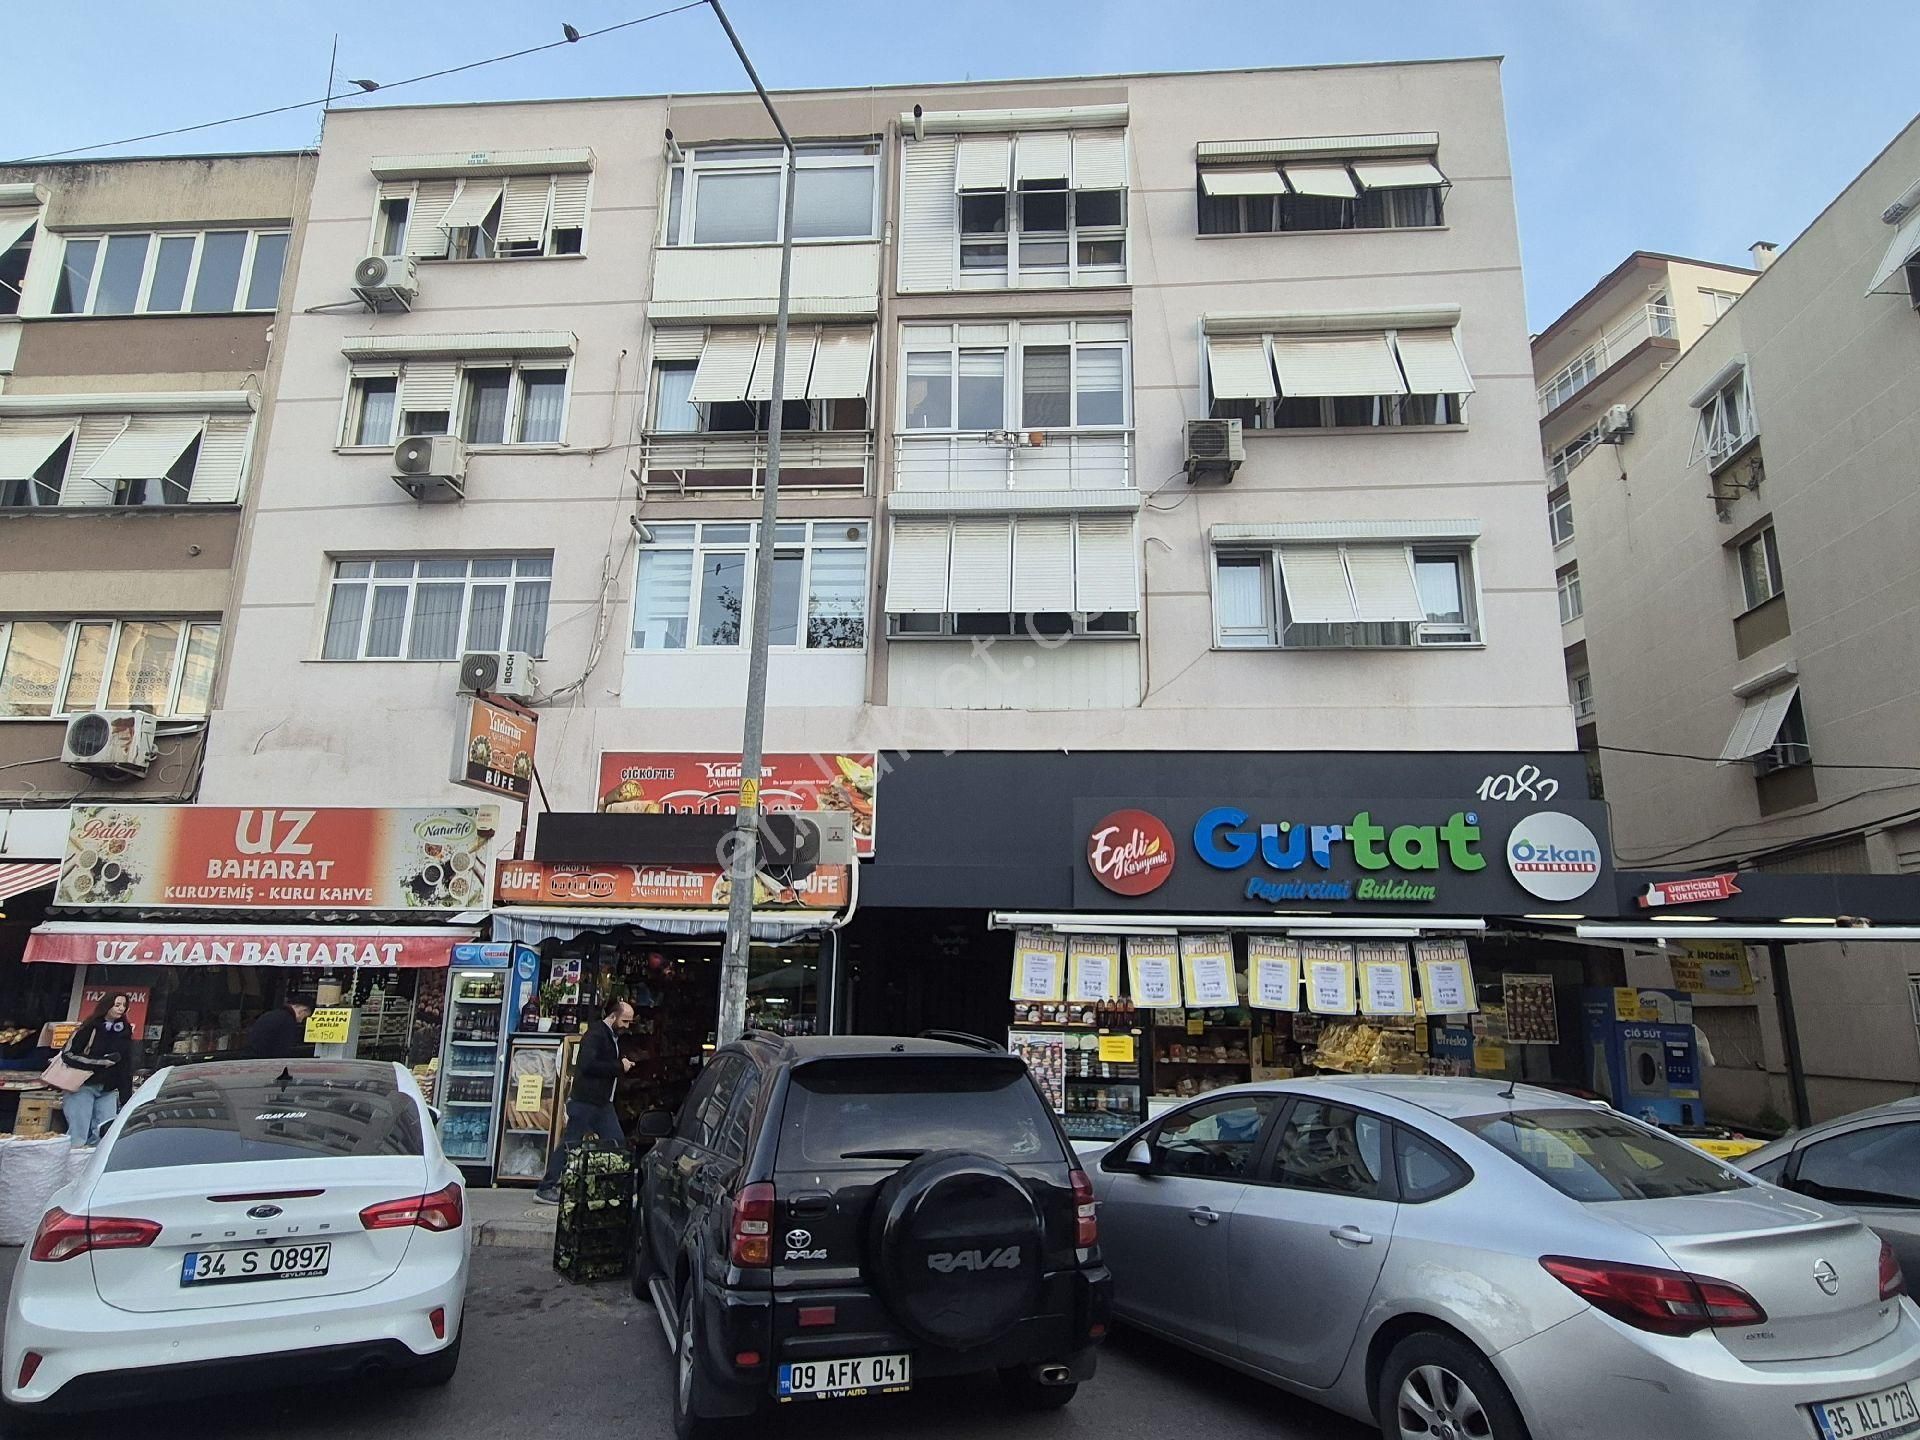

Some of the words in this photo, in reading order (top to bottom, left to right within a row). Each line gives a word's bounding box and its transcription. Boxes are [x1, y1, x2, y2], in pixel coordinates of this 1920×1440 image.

[504, 654, 515, 684] BOSCH
[485, 769, 515, 791] BÜFE
[235, 810, 316, 854] UZ
[1193, 807, 1487, 871] Gürtat
[1092, 826, 1149, 880] Egeli
[1512, 838, 1595, 862] Özkan
[207, 859, 334, 880] BAHARAT
[624, 864, 706, 887] Yıldırım
[1123, 851, 1168, 876] Kuruyemiş
[501, 868, 541, 890] BÜFE
[806, 872, 838, 893] ÜFE
[1357, 878, 1436, 900] Buldum
[164, 884, 254, 902] KURUYEMİŞ
[269, 887, 315, 900] KURU
[320, 888, 373, 900] KAHVE
[96, 941, 139, 963] UZ
[159, 942, 235, 964] MAN
[239, 942, 403, 966] BAHARAT
[191, 1224, 330, 1238] FOCUS
[197, 1254, 226, 1277] 34
[241, 1252, 259, 1273] S
[270, 1246, 329, 1271] 0897
[785, 1249, 827, 1261] RAV4
[928, 1246, 1021, 1272] RAV4
[791, 1366, 816, 1390] 09
[826, 1361, 861, 1387] AFK
[872, 1357, 906, 1382] 041
[847, 1388, 868, 1397] AUTO
[1828, 1406, 1854, 1438] 35
[1856, 1398, 1888, 1432] ALZ
[1885, 1390, 1915, 1422] 223
